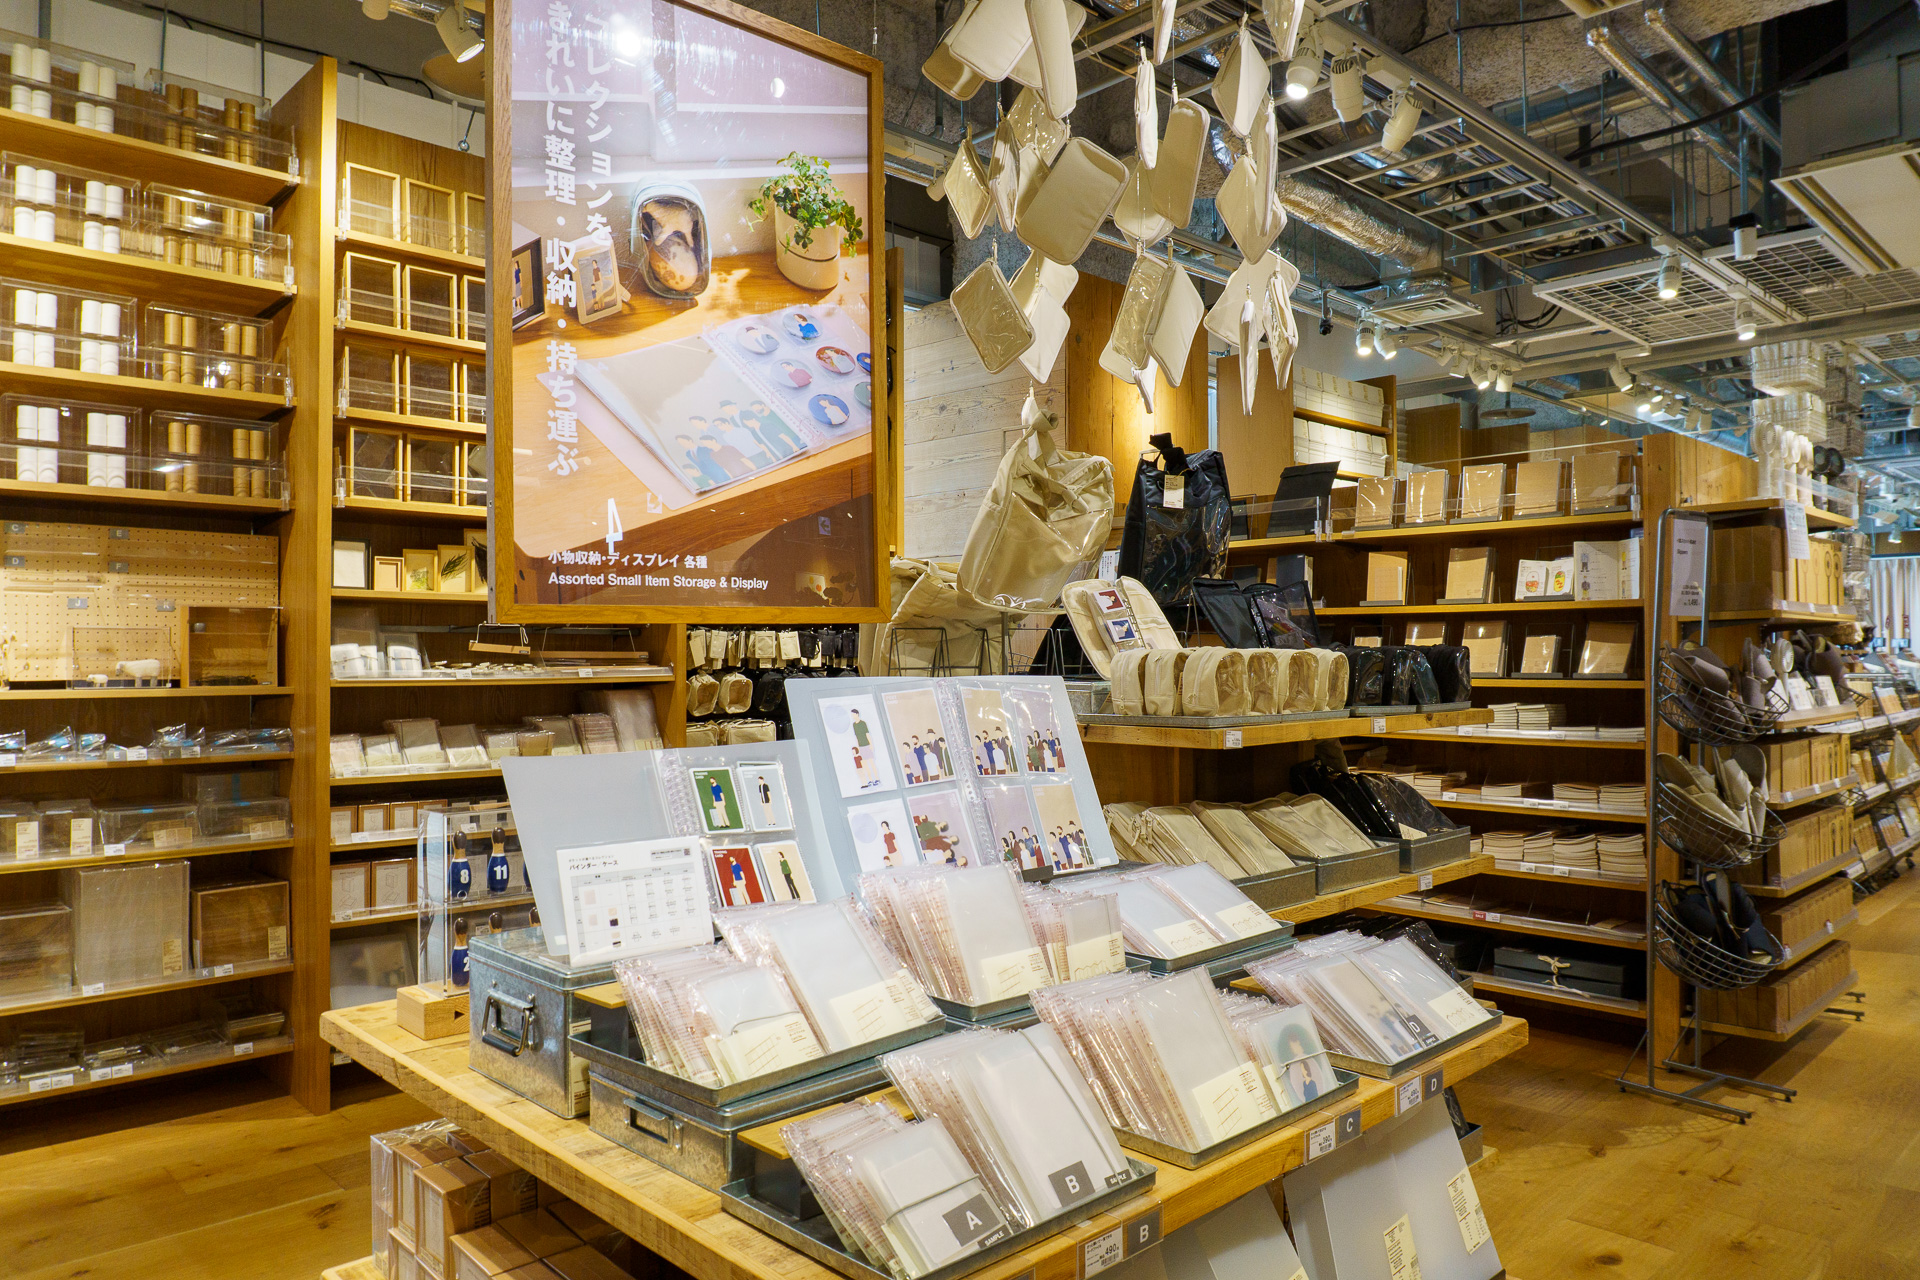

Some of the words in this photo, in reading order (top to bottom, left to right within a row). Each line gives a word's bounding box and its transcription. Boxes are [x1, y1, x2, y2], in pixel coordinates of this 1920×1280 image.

[585, 14, 614, 247] コレクションを
[11, 523, 19, 532] C
[12, 557, 20, 565] D
[115, 563, 122, 571] F
[684, 555, 708, 568] 各種
[548, 573, 604, 585] Assorted
[608, 573, 642, 586] Small
[645, 574, 670, 587] Item
[673, 575, 716, 589] Storage
[719, 577, 728, 588] &
[731, 577, 769, 590] Display
[75, 599, 82, 607] J
[460, 869, 470, 884] 8
[493, 865, 508, 880] 11
[202, 969, 209, 977] K
[1409, 1021, 1421, 1033] D
[1431, 1078, 1437, 1092] D
[1346, 1117, 1354, 1133] C
[1065, 1174, 1080, 1194] B
[965, 1210, 983, 1231] A
[984, 1230, 1005, 1247] SAMPLE
[1139, 1224, 1149, 1243] B
[1105, 1243, 1117, 1256] 490
